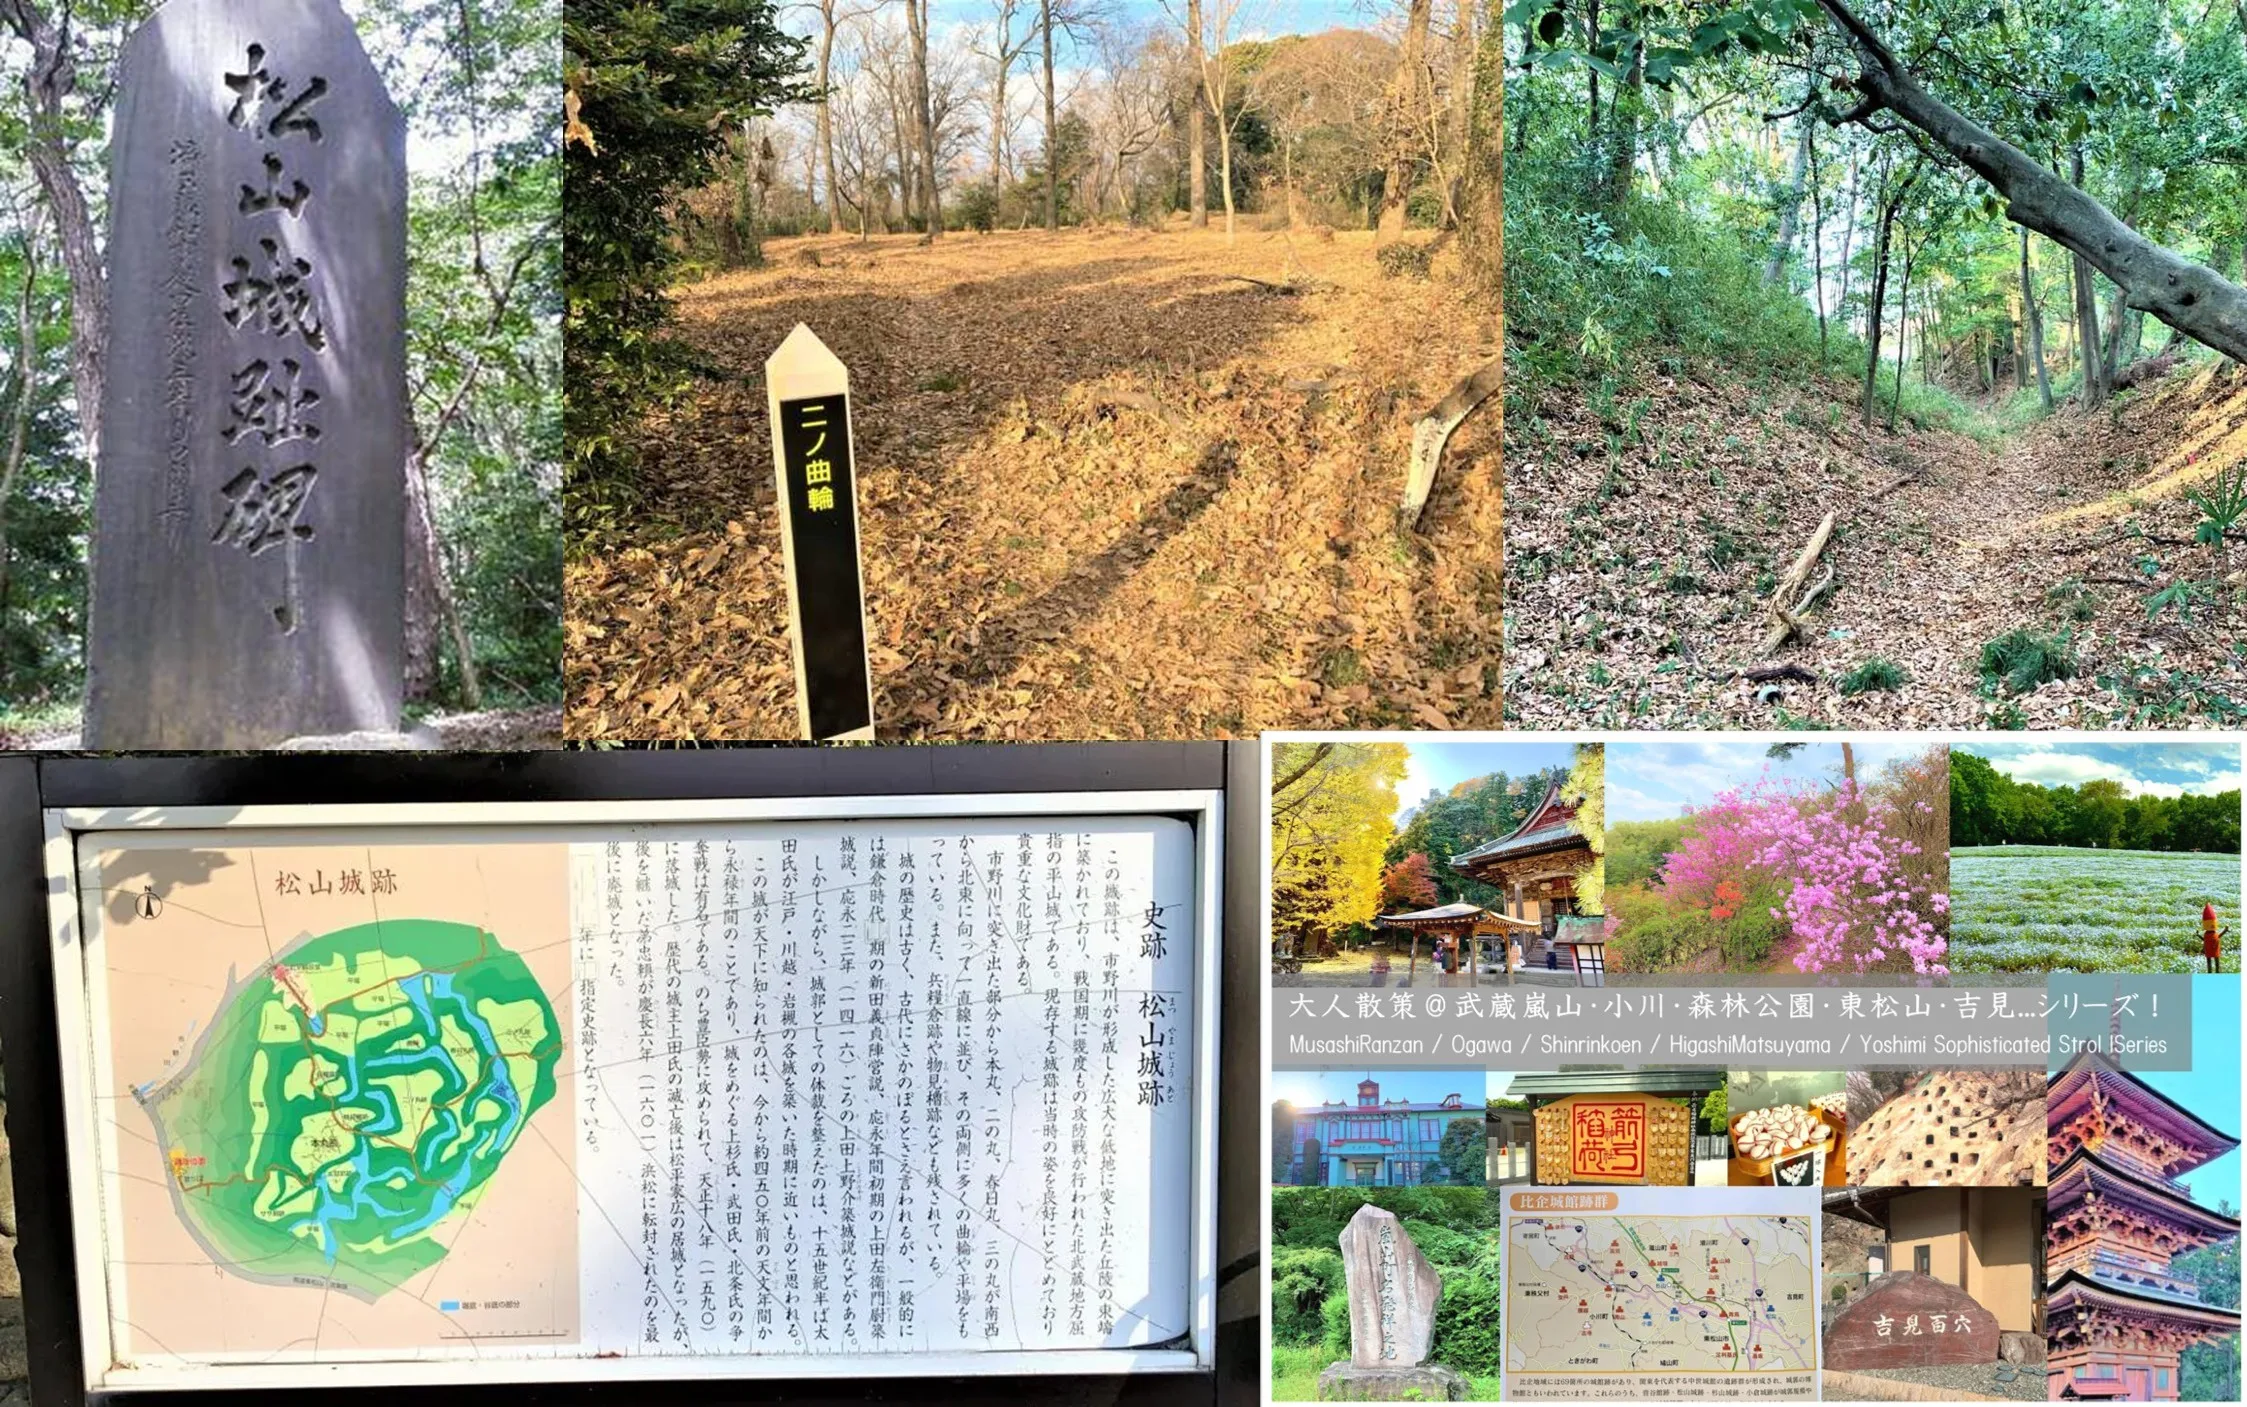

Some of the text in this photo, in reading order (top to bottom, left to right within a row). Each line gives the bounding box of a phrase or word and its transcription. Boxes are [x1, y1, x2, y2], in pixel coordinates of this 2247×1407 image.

[801, 404, 835, 511] 二ノ曲輪
[144, 884, 152, 892] N
[275, 868, 399, 896] 松山城跡
[606, 841, 625, 987] 後に廃城となった。
[1016, 833, 1033, 995] 貴重な文化財である。
[1137, 901, 1168, 1107] 史跡 松山城跡
[579, 926, 600, 1153] 年に指定史跡となっている。
[1520, 1194, 1609, 1209] 比企城館跡群
[1872, 1313, 1972, 1337] 吉見百穴
[1568, 1357, 1599, 1365] ときがわ町
